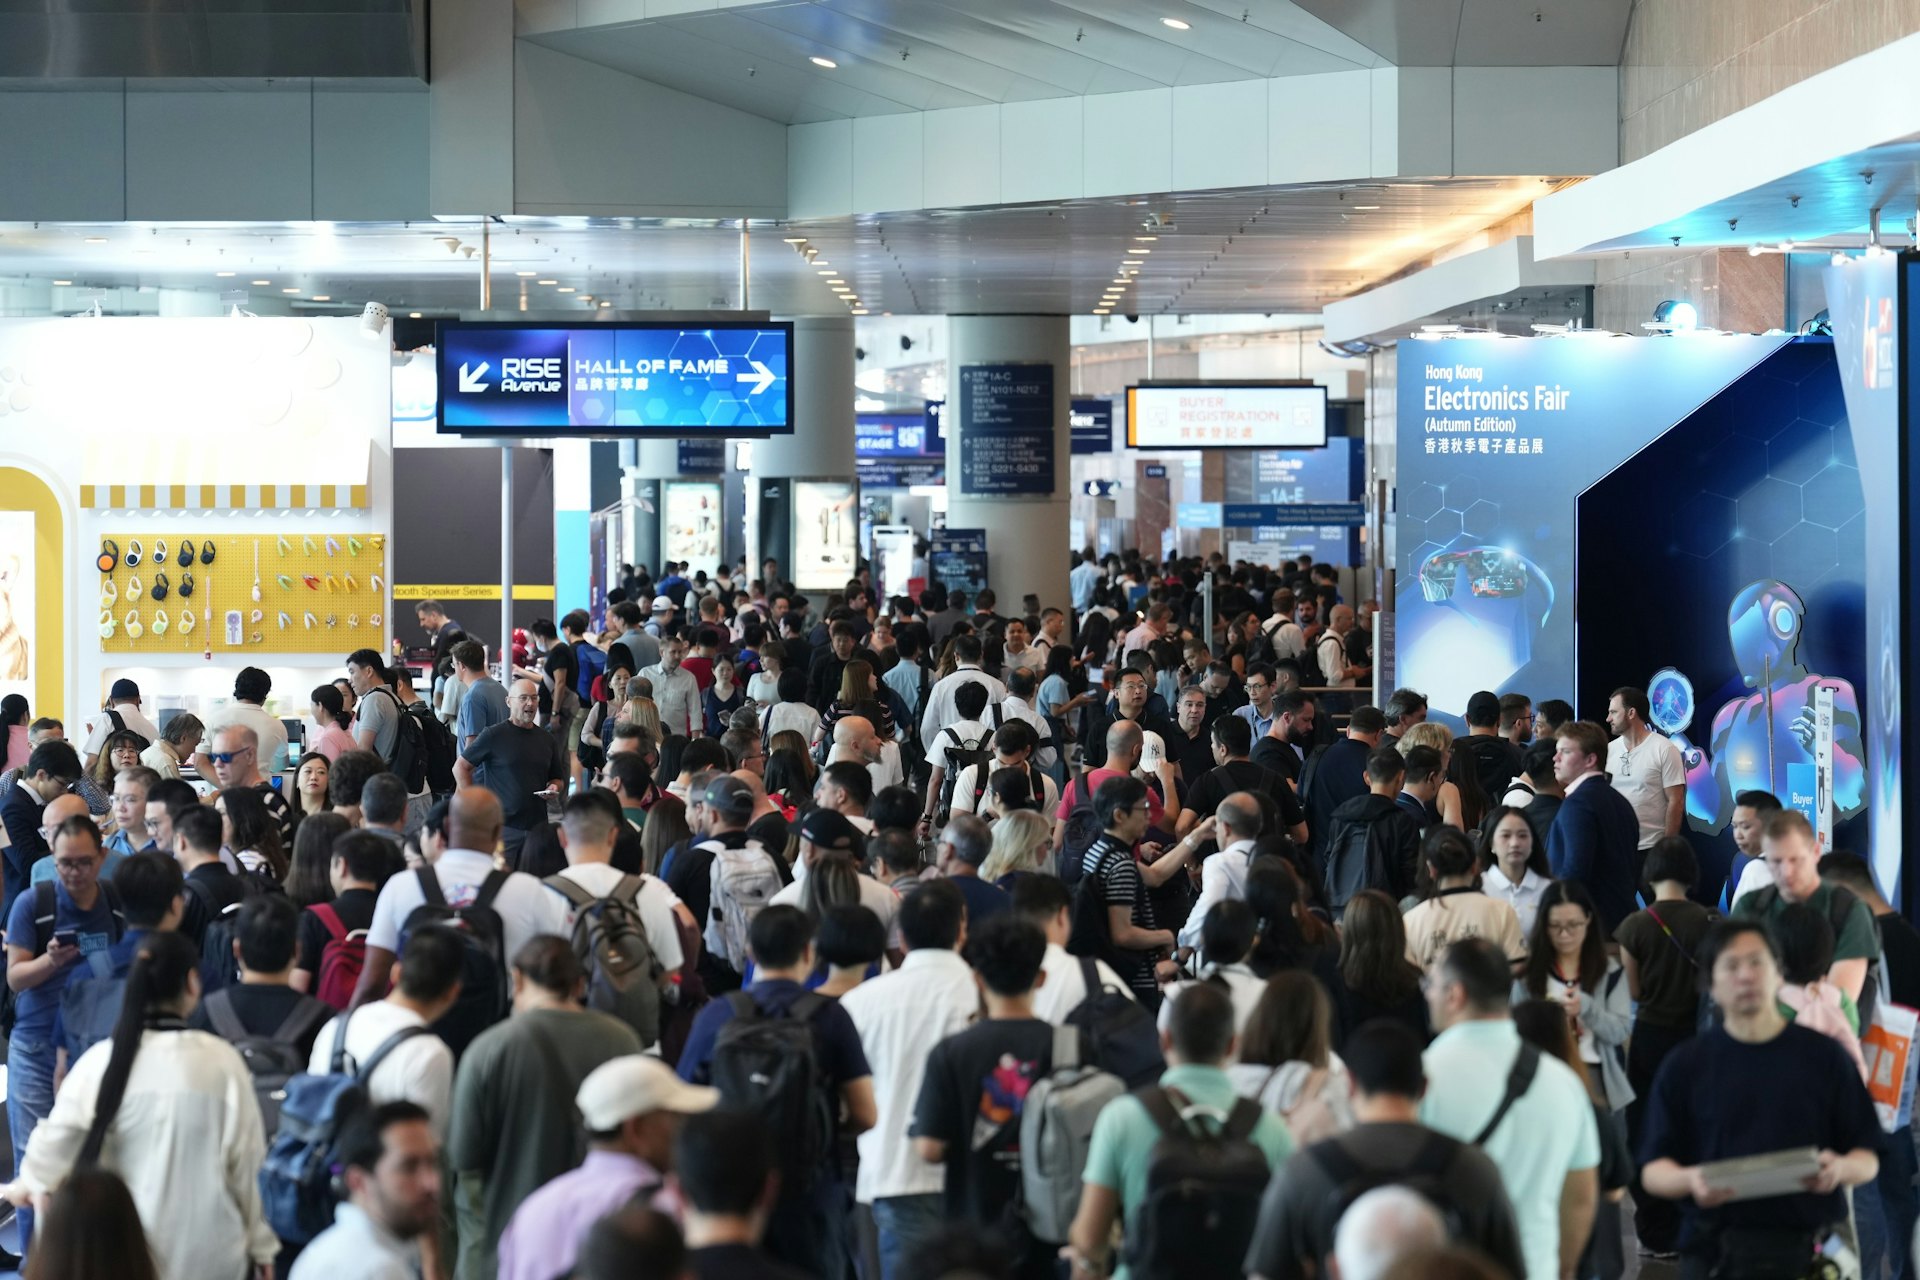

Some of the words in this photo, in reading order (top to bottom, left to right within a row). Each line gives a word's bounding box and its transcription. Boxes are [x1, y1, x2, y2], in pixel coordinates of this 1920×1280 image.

[502, 358, 561, 378] RISE
[575, 359, 633, 374] HALL
[636, 359, 666, 374] OF
[669, 359, 728, 374] FAME
[1425, 364, 1453, 382] Hong
[1455, 364, 1483, 382] Kong
[501, 378, 562, 392] Avenue
[1179, 397, 1224, 408] BUYER
[1424, 385, 1529, 411] Electronics
[1534, 385, 1570, 411] Fair
[1179, 411, 1280, 422] REGISTRATION
[1424, 416, 1471, 433] (Autumn
[1473, 416, 1517, 433] Edition)
[1424, 438, 1544, 454] 香港秋季電子產品展
[421, 586, 460, 597] Speaker
[463, 586, 492, 596] Series
[1792, 792, 1813, 808] Buyer
